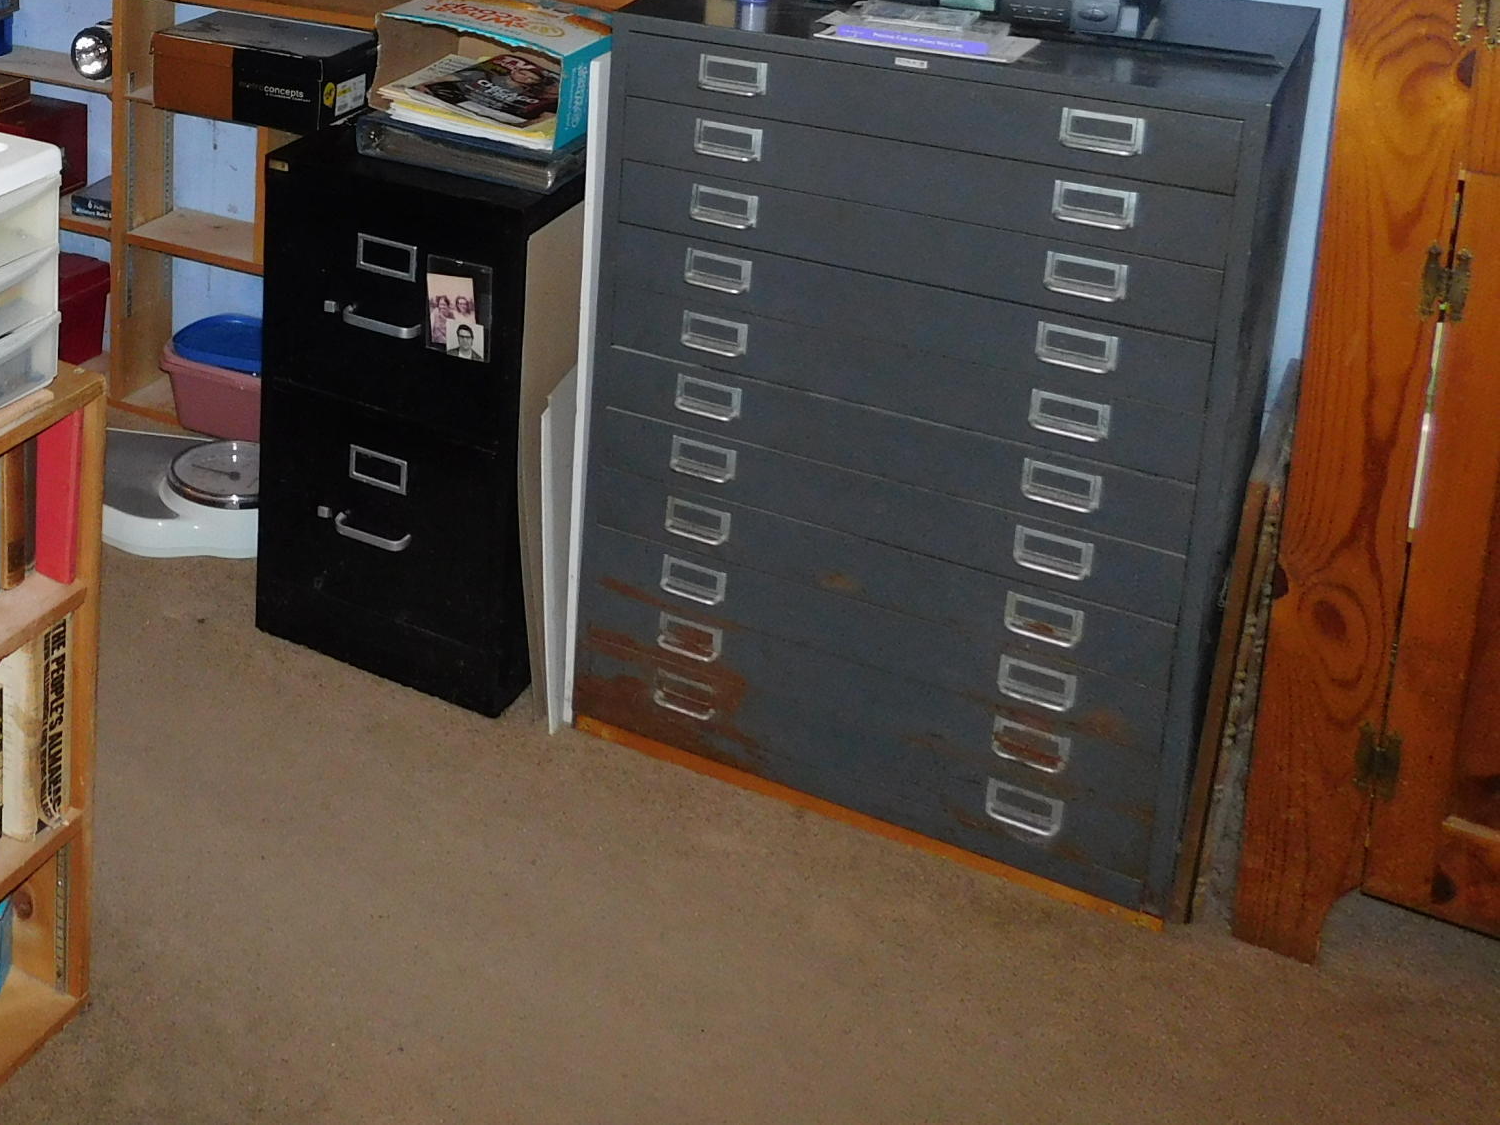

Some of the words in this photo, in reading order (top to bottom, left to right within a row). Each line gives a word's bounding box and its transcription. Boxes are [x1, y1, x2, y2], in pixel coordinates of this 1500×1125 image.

[477, 79, 539, 104] CHICAGO
[50, 619, 66, 654] THE
[50, 654, 66, 729] PEOPLE'S
